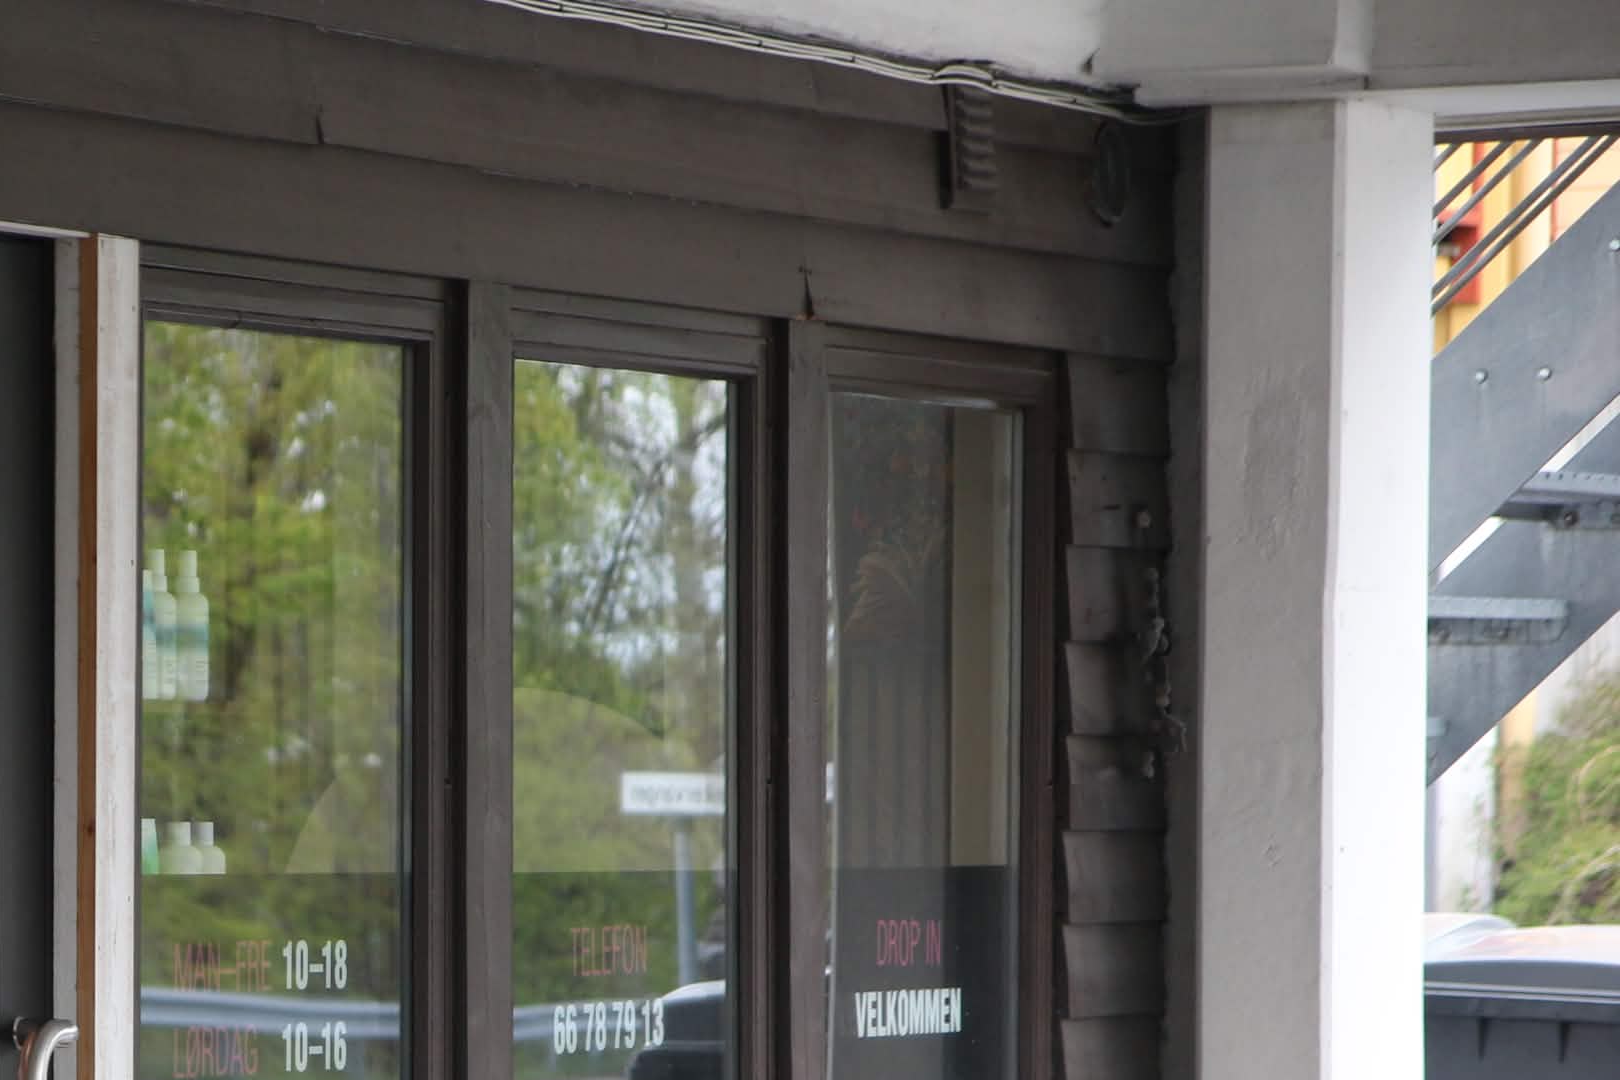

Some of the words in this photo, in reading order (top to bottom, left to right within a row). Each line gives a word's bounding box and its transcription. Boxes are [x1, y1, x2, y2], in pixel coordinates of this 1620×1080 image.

[570, 925, 648, 977] TELEFON
[876, 919, 921, 966] DROP
[925, 919, 941, 966] IN
[553, 1003, 578, 1055] 66
[583, 1001, 607, 1052] 78
[612, 999, 636, 1050] 79
[641, 998, 665, 1047] 13
[854, 987, 962, 1038] VELKOMMEN
[172, 1024, 260, 1079] LØRDAG
